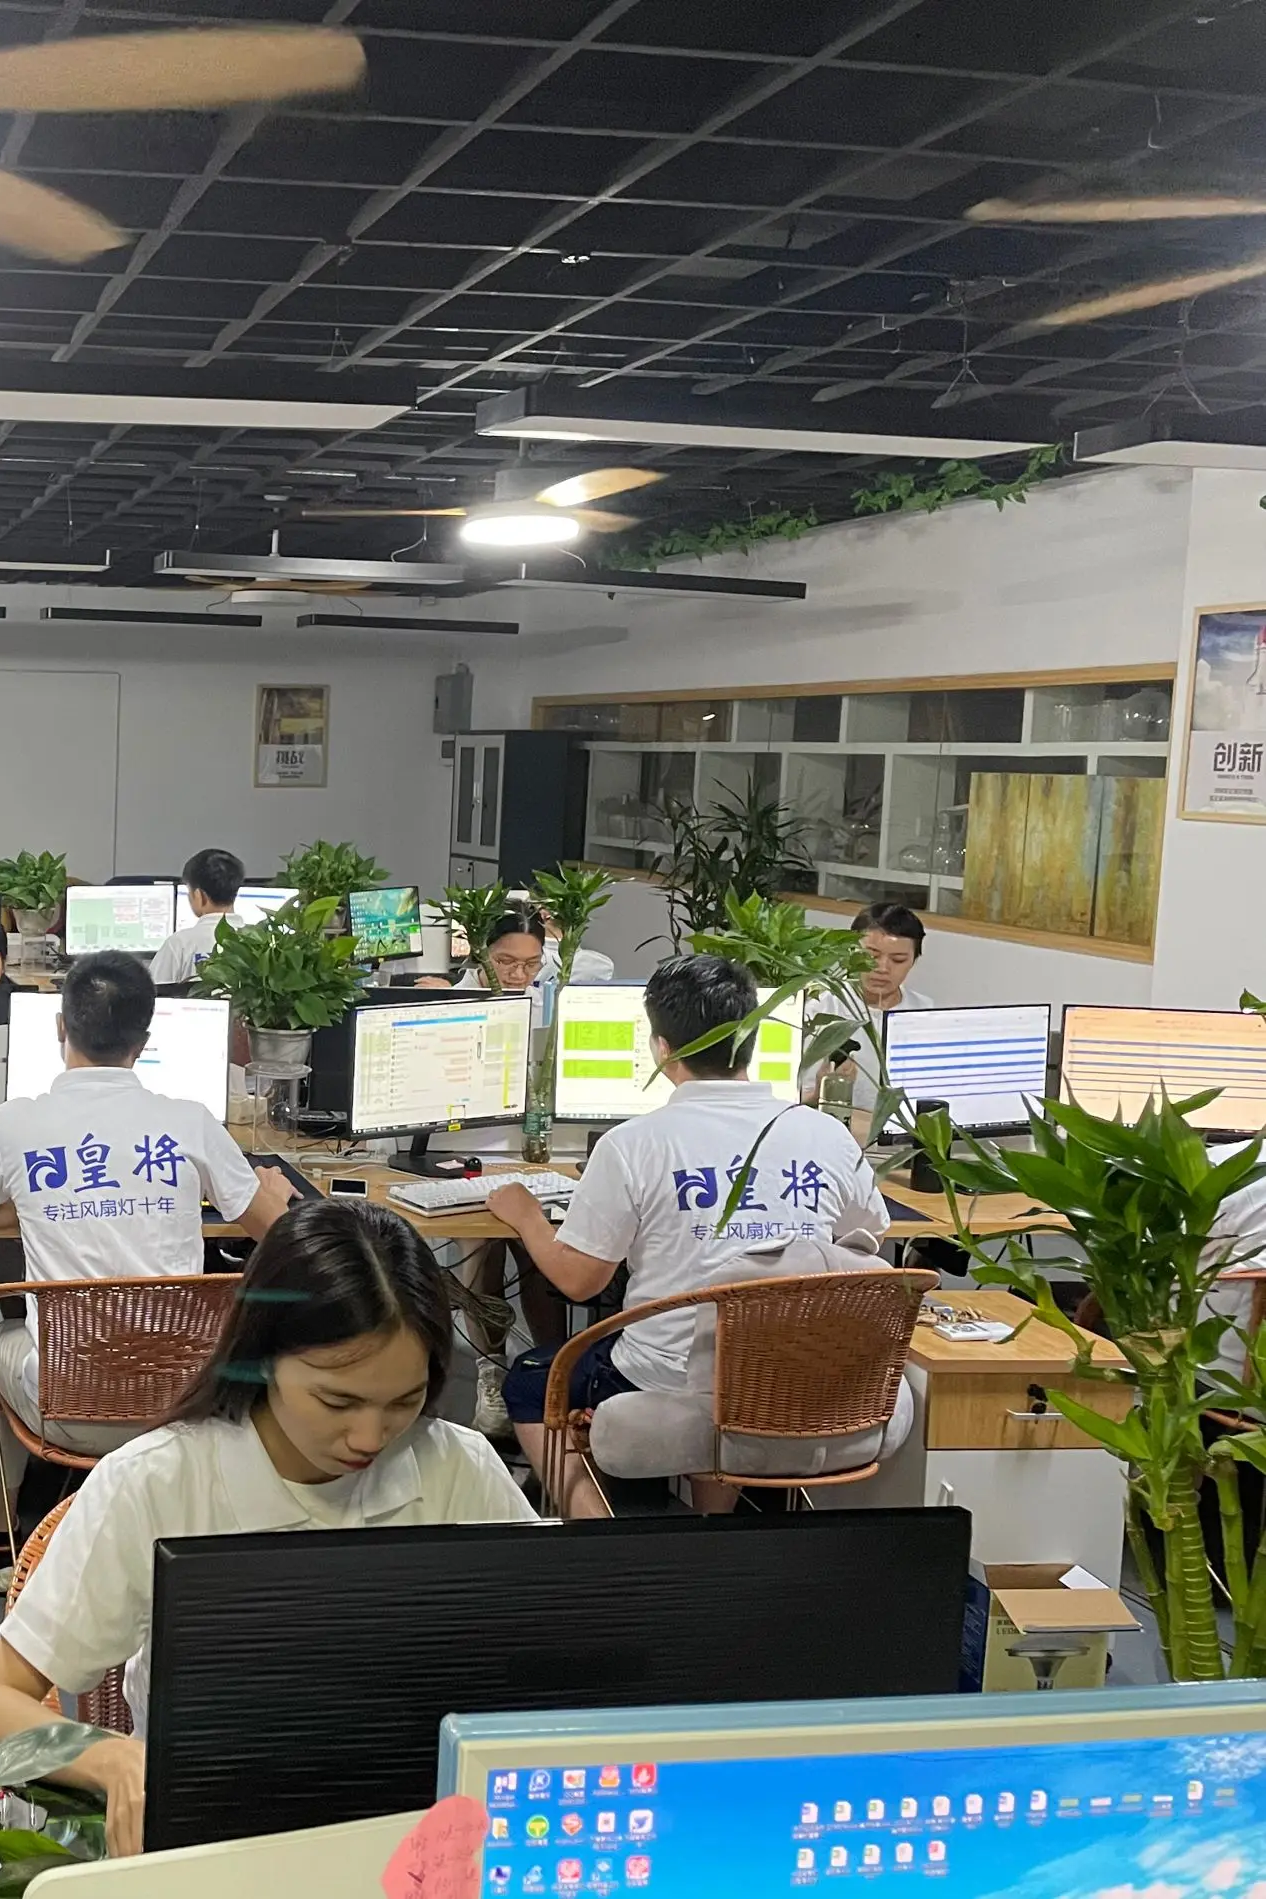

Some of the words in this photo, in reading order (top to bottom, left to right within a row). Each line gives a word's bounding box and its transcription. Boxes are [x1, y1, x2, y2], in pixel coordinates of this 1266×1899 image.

[1213, 742, 1264, 772] 创新
[74, 1133, 186, 1193] 皇将
[723, 1154, 830, 1213] 皇将
[43, 1196, 176, 1222] 专注风扇灯十年
